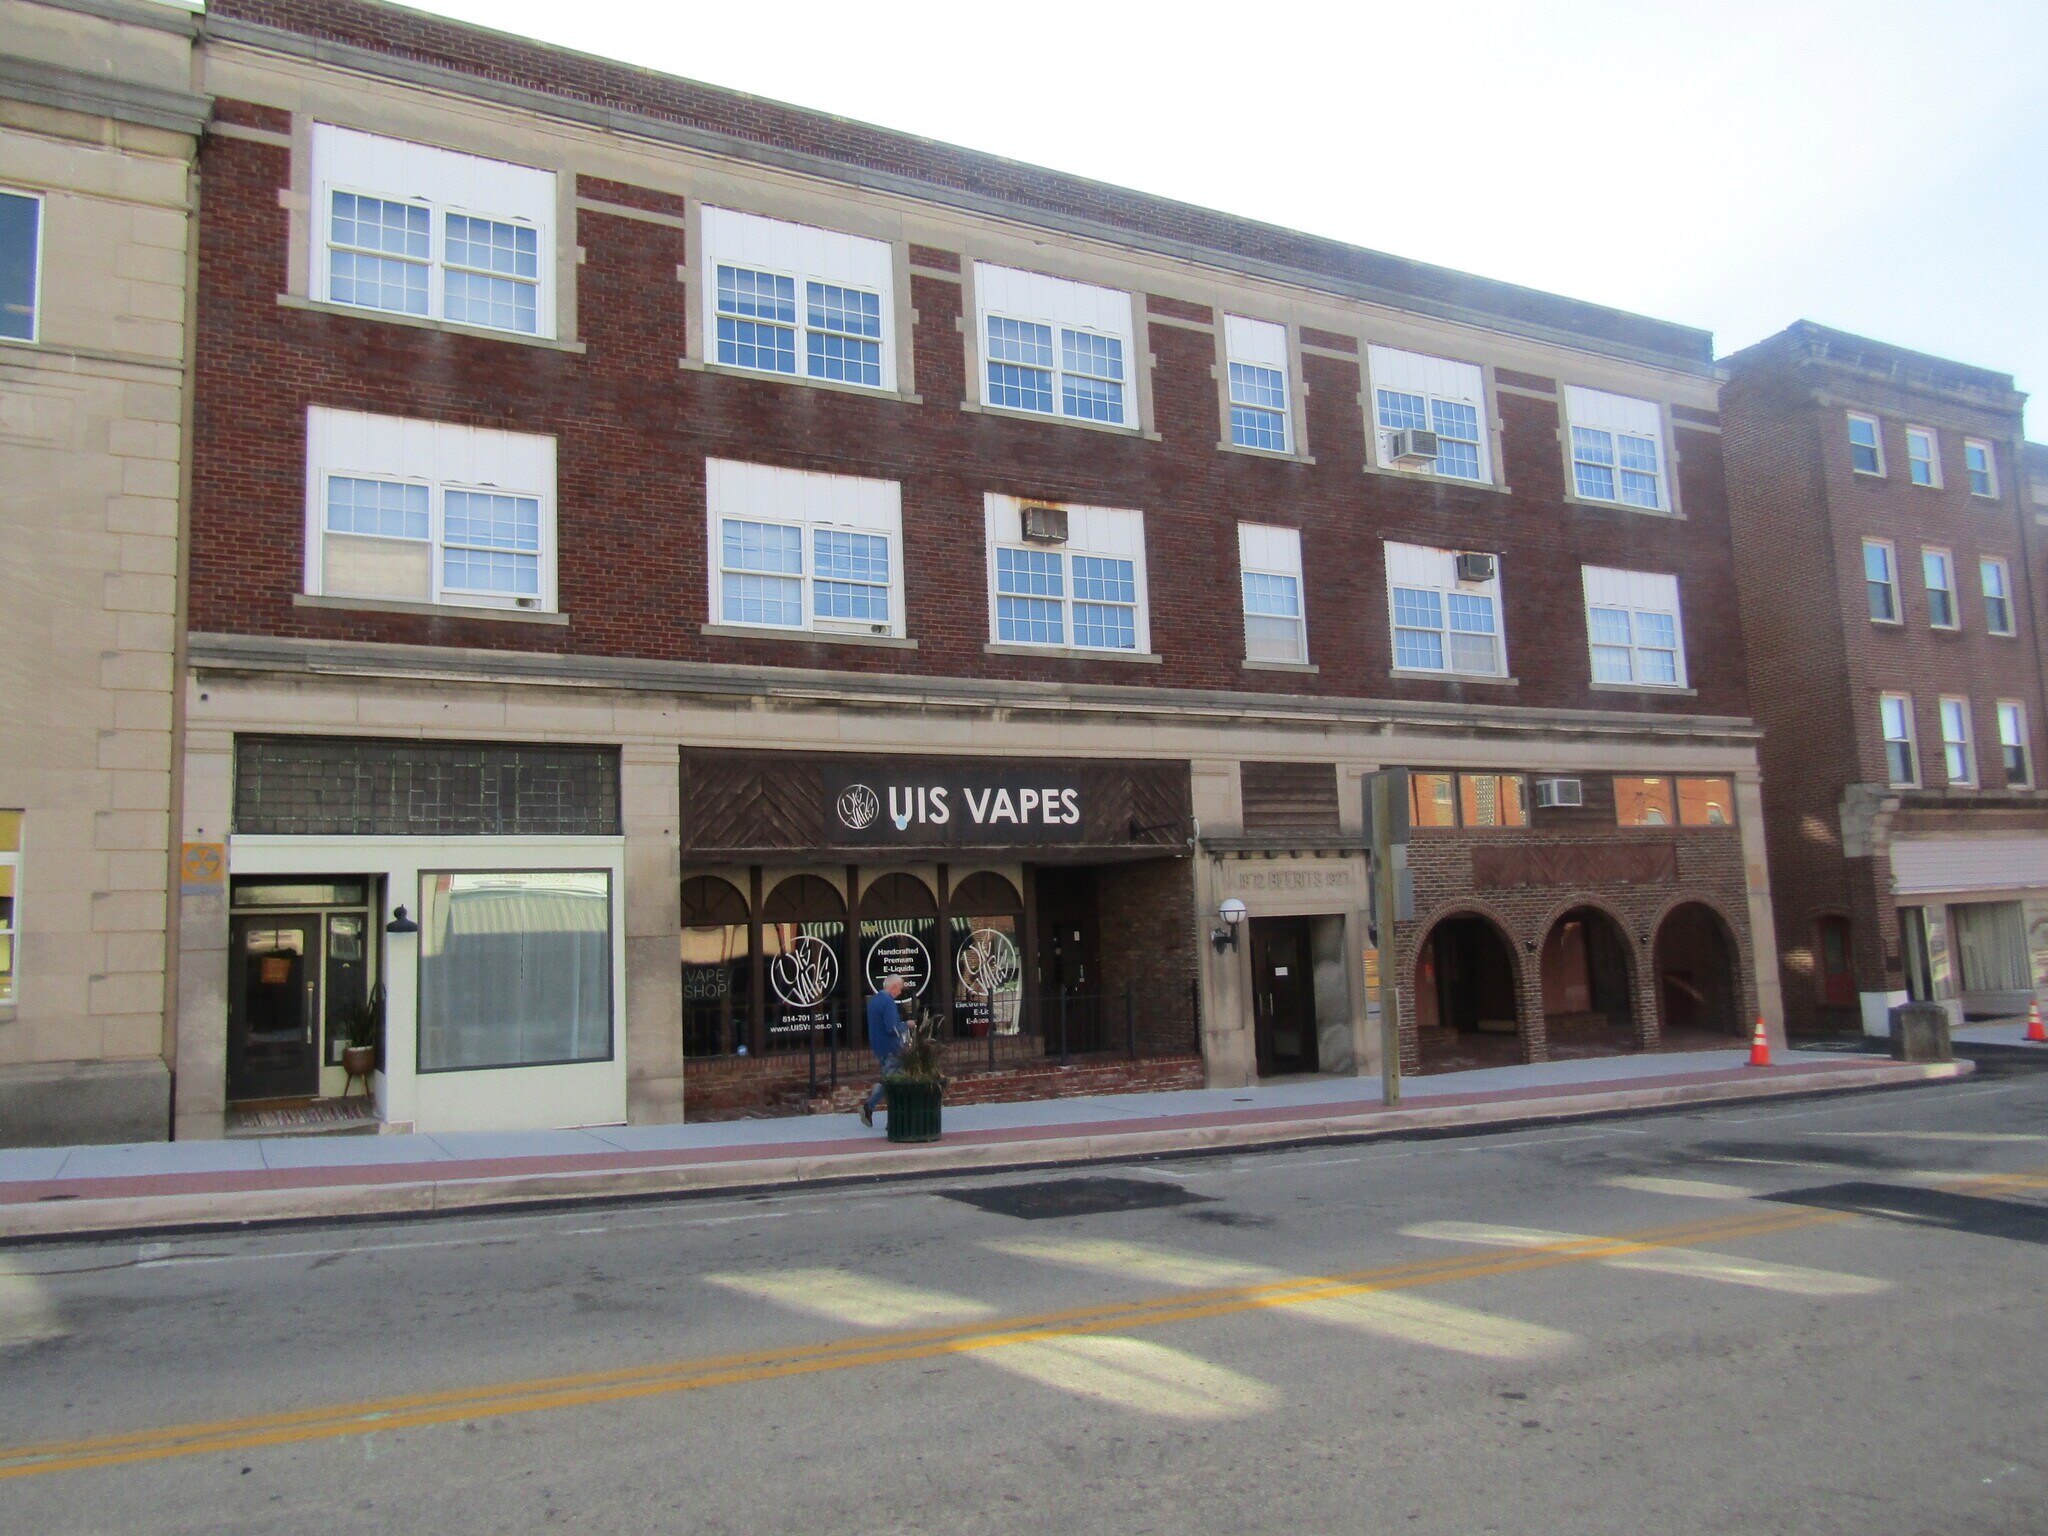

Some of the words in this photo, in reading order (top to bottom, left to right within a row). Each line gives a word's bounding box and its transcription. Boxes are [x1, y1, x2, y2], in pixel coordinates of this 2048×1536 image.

[888, 785, 950, 826] UIS
[963, 786, 1080, 825] VAPES
[877, 947, 919, 956] Handcrafted
[883, 956, 914, 964] Premium
[883, 964, 915, 973] E-Liquids
[685, 968, 725, 984] VAPE
[684, 984, 728, 1000] SHOP
[769, 1022, 842, 1033] www.UISVaes.cm
